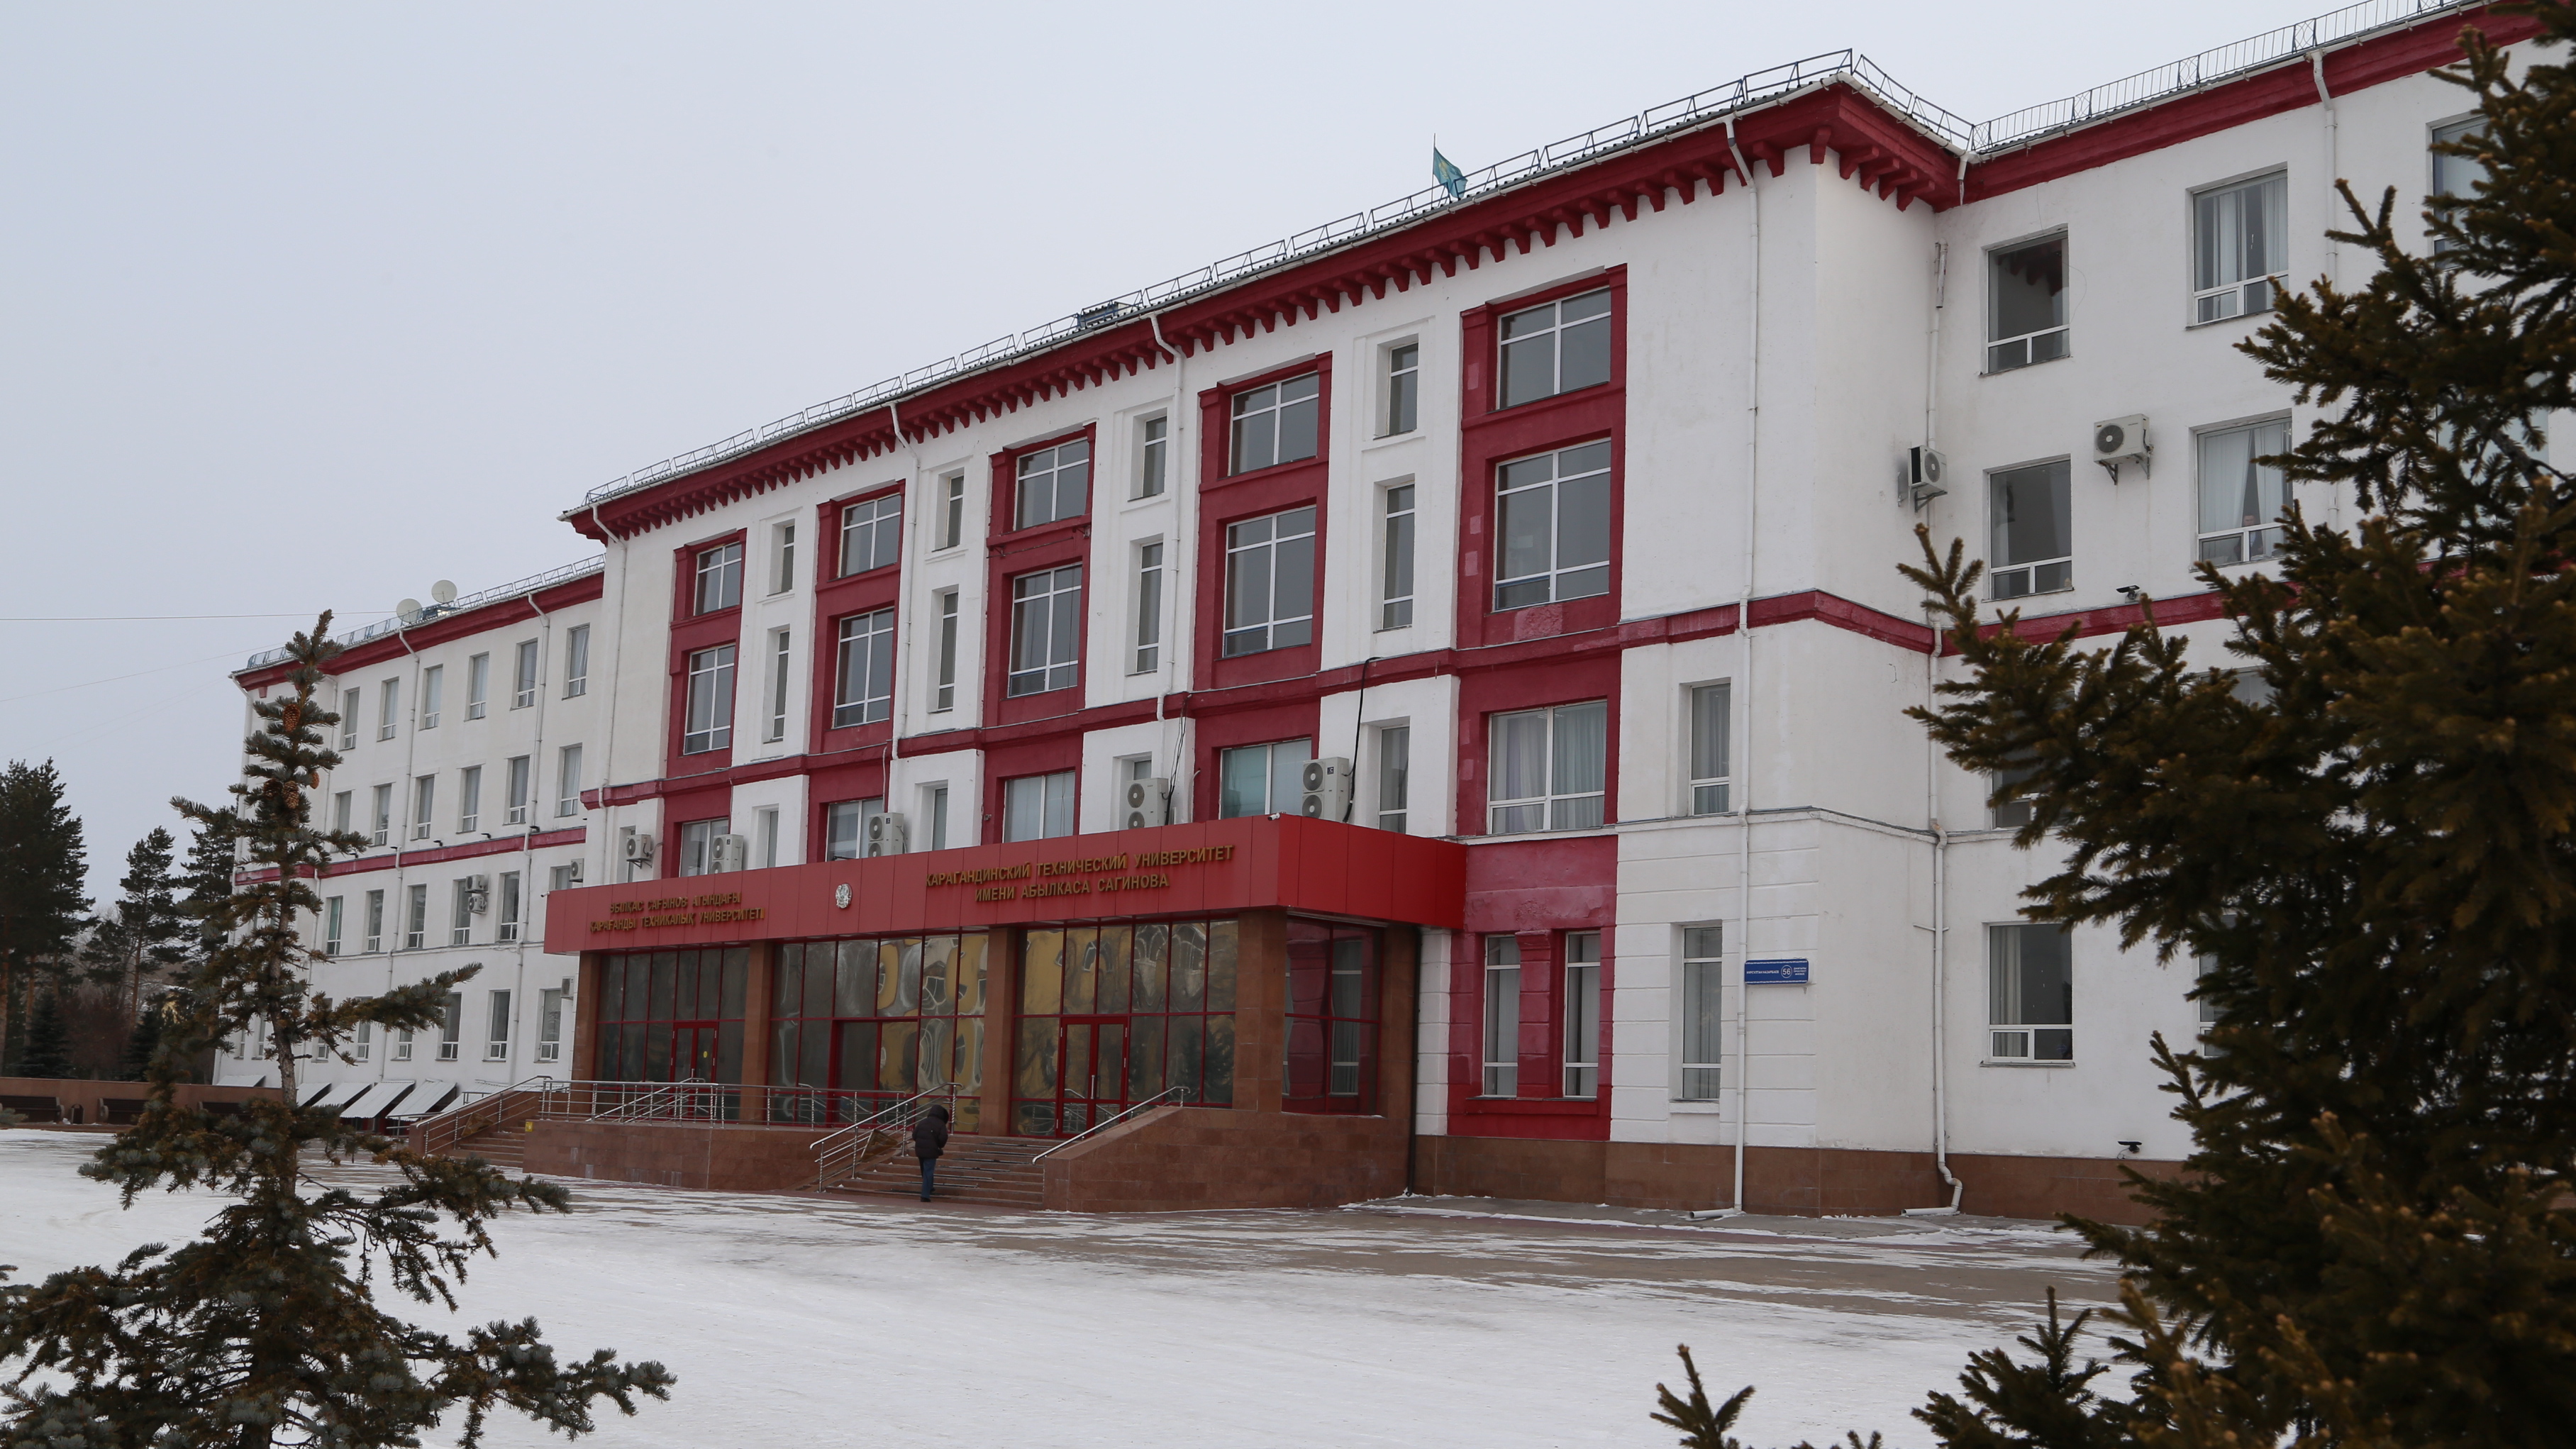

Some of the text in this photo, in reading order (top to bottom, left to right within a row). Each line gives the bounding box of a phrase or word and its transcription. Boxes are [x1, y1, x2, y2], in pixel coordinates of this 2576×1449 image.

[926, 845, 1235, 887] КАРАГАНДИНСКИЙ ТЕХНИЧЕСКИЙ УНИВЕРСИТЕТ
[975, 873, 1170, 902] ИМЕНИ АБЫЛКАСА САГИНОВА
[648, 896, 688, 911] САҒЫНОВ
[692, 892, 742, 907] АТЫНДАҒЫ
[590, 907, 765, 932] ҚАРАҒАНДЫ ТЕХНИКАЛЫҚ УНИВЕРСИТЕТІ
